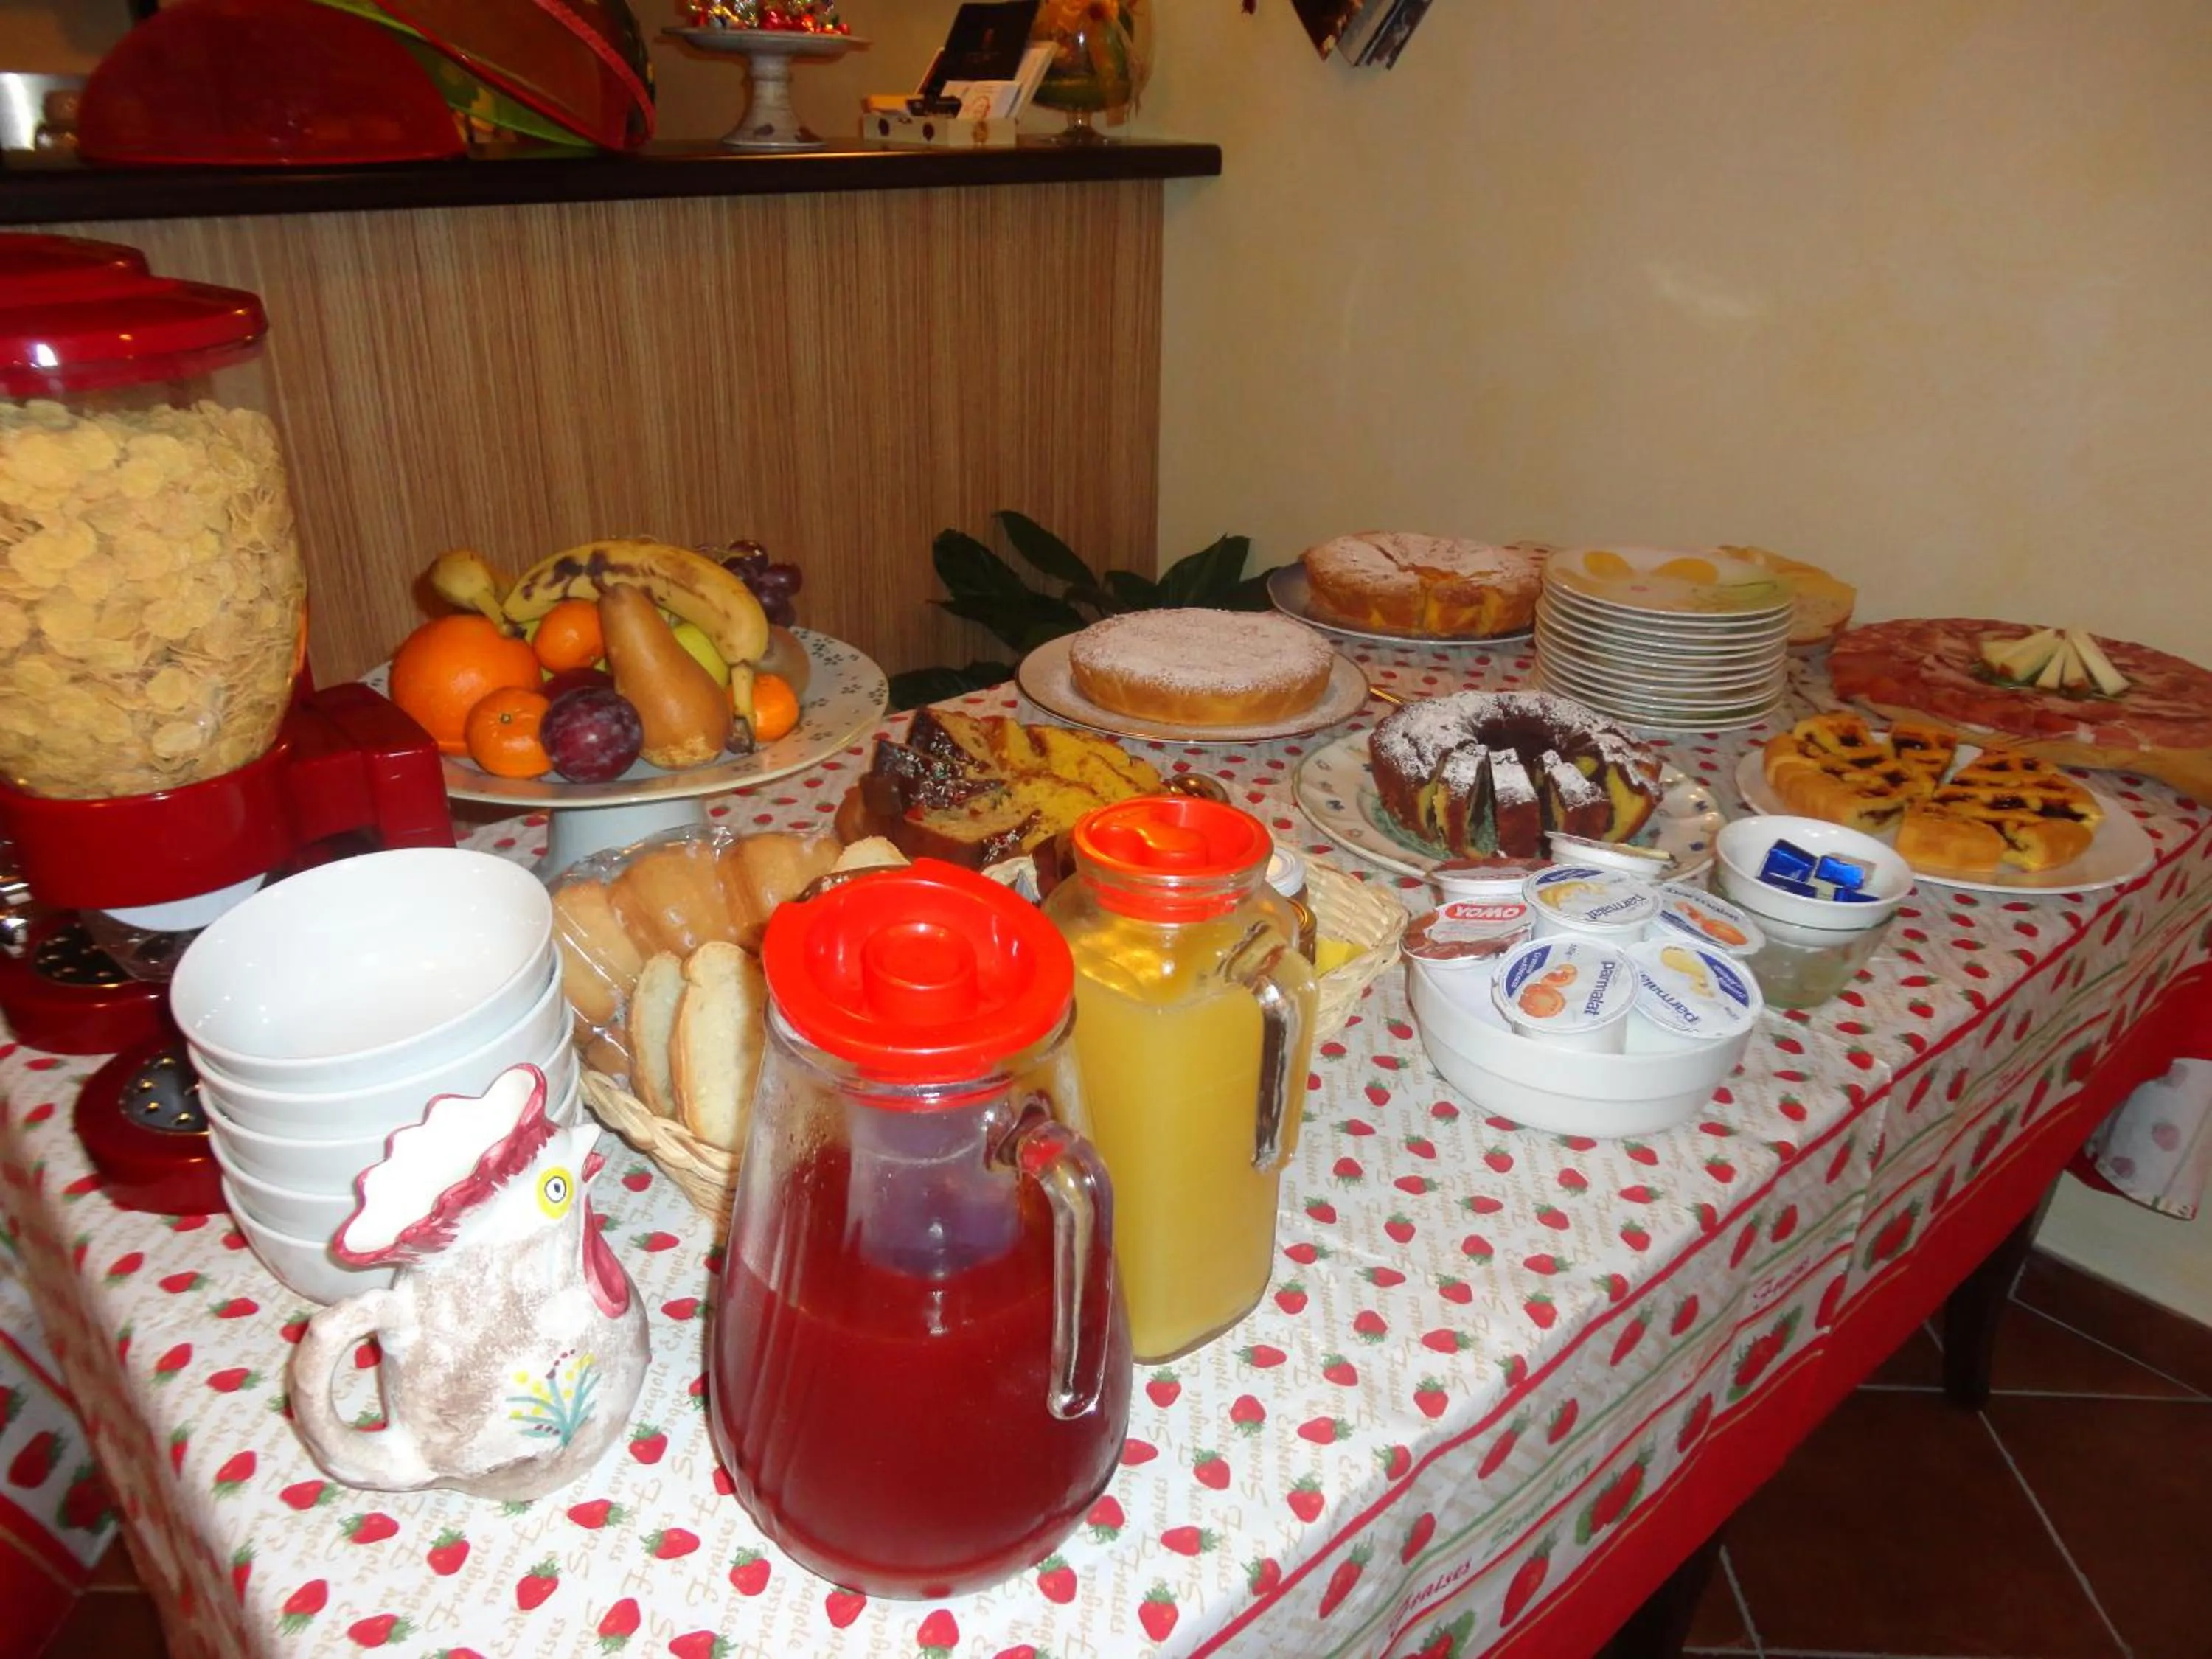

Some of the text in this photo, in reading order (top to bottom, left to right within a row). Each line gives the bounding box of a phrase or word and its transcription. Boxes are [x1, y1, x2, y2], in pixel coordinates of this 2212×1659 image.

[1455, 905, 1520, 919] YOMO
[1583, 960, 1615, 1017] parmalat
[685, 1516, 737, 1607] Fraises
[1389, 1557, 1472, 1638] Fraises
